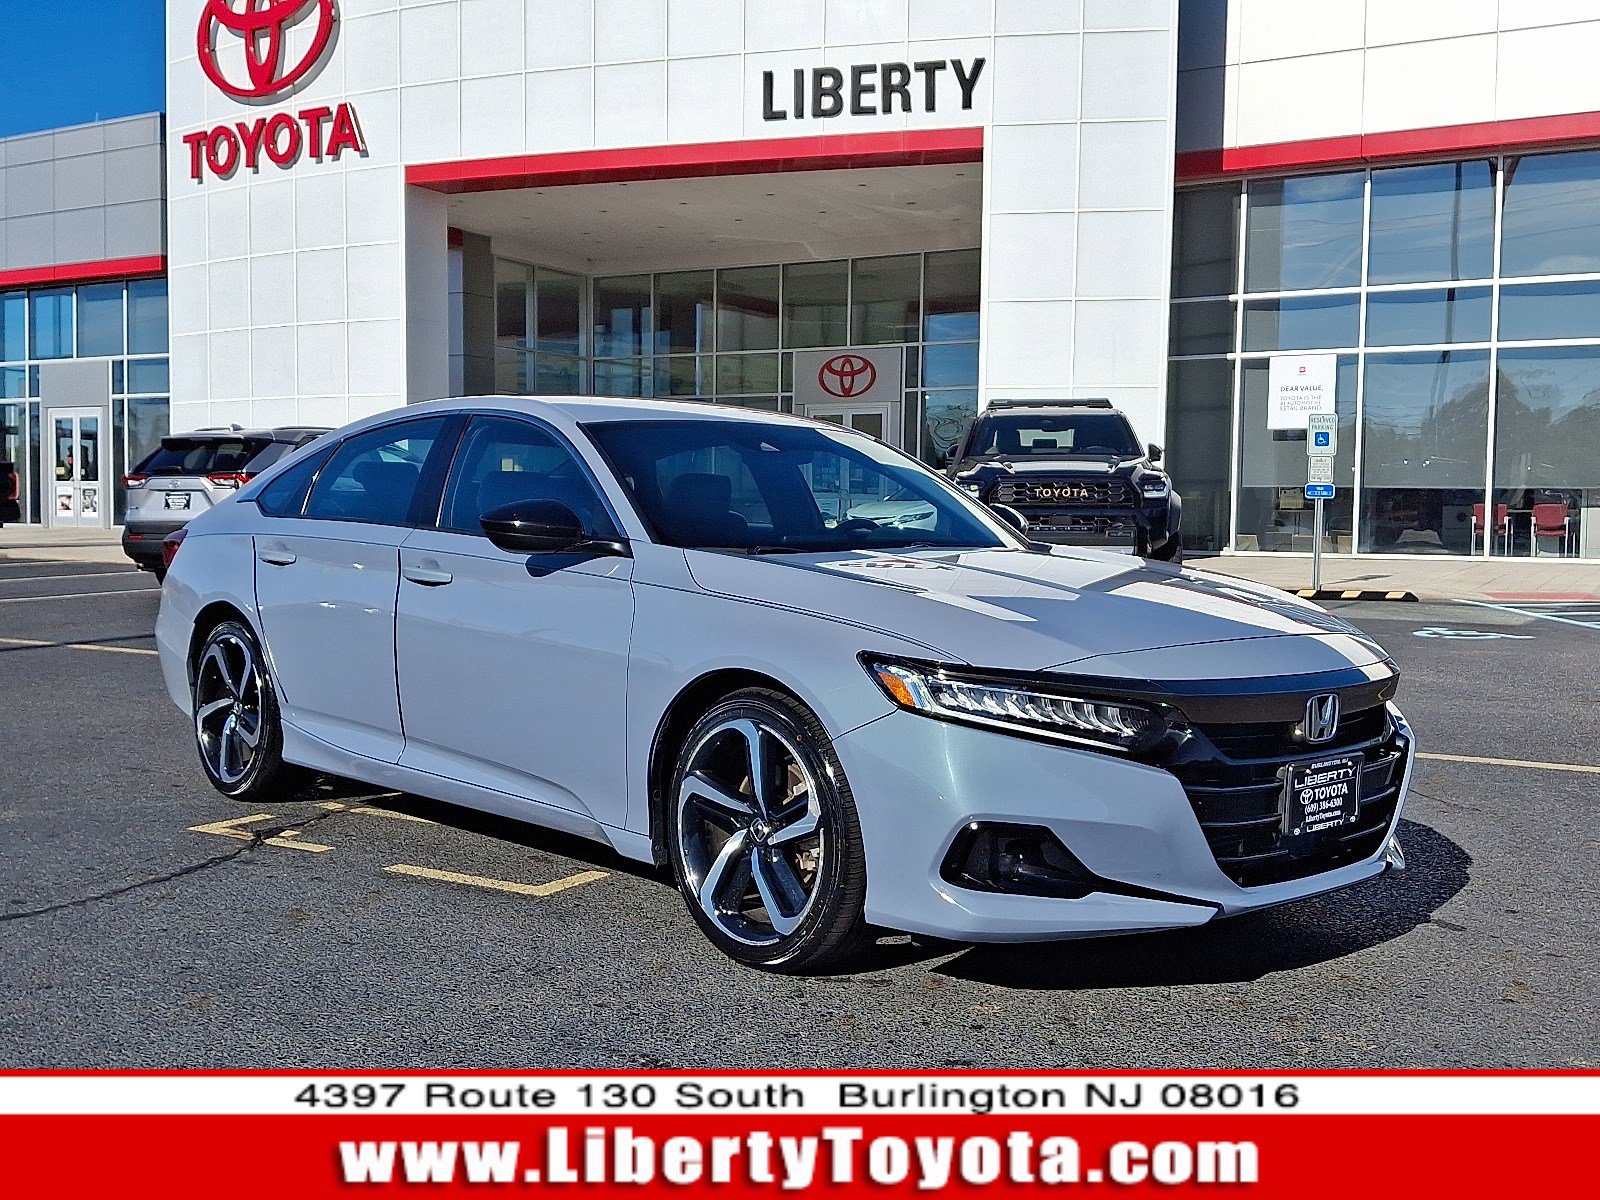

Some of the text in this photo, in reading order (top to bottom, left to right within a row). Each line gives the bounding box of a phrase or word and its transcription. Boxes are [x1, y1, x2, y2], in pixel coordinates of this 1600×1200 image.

[763, 57, 986, 121] LIBERTY
[183, 102, 368, 183] TOYOTA
[1034, 488, 1089, 498] TOYOTA
[1294, 766, 1357, 789] LIBERTY
[1314, 782, 1349, 801] TOYOTA
[1304, 802, 1319, 816] (609)
[1306, 818, 1344, 833] LIBERTY
